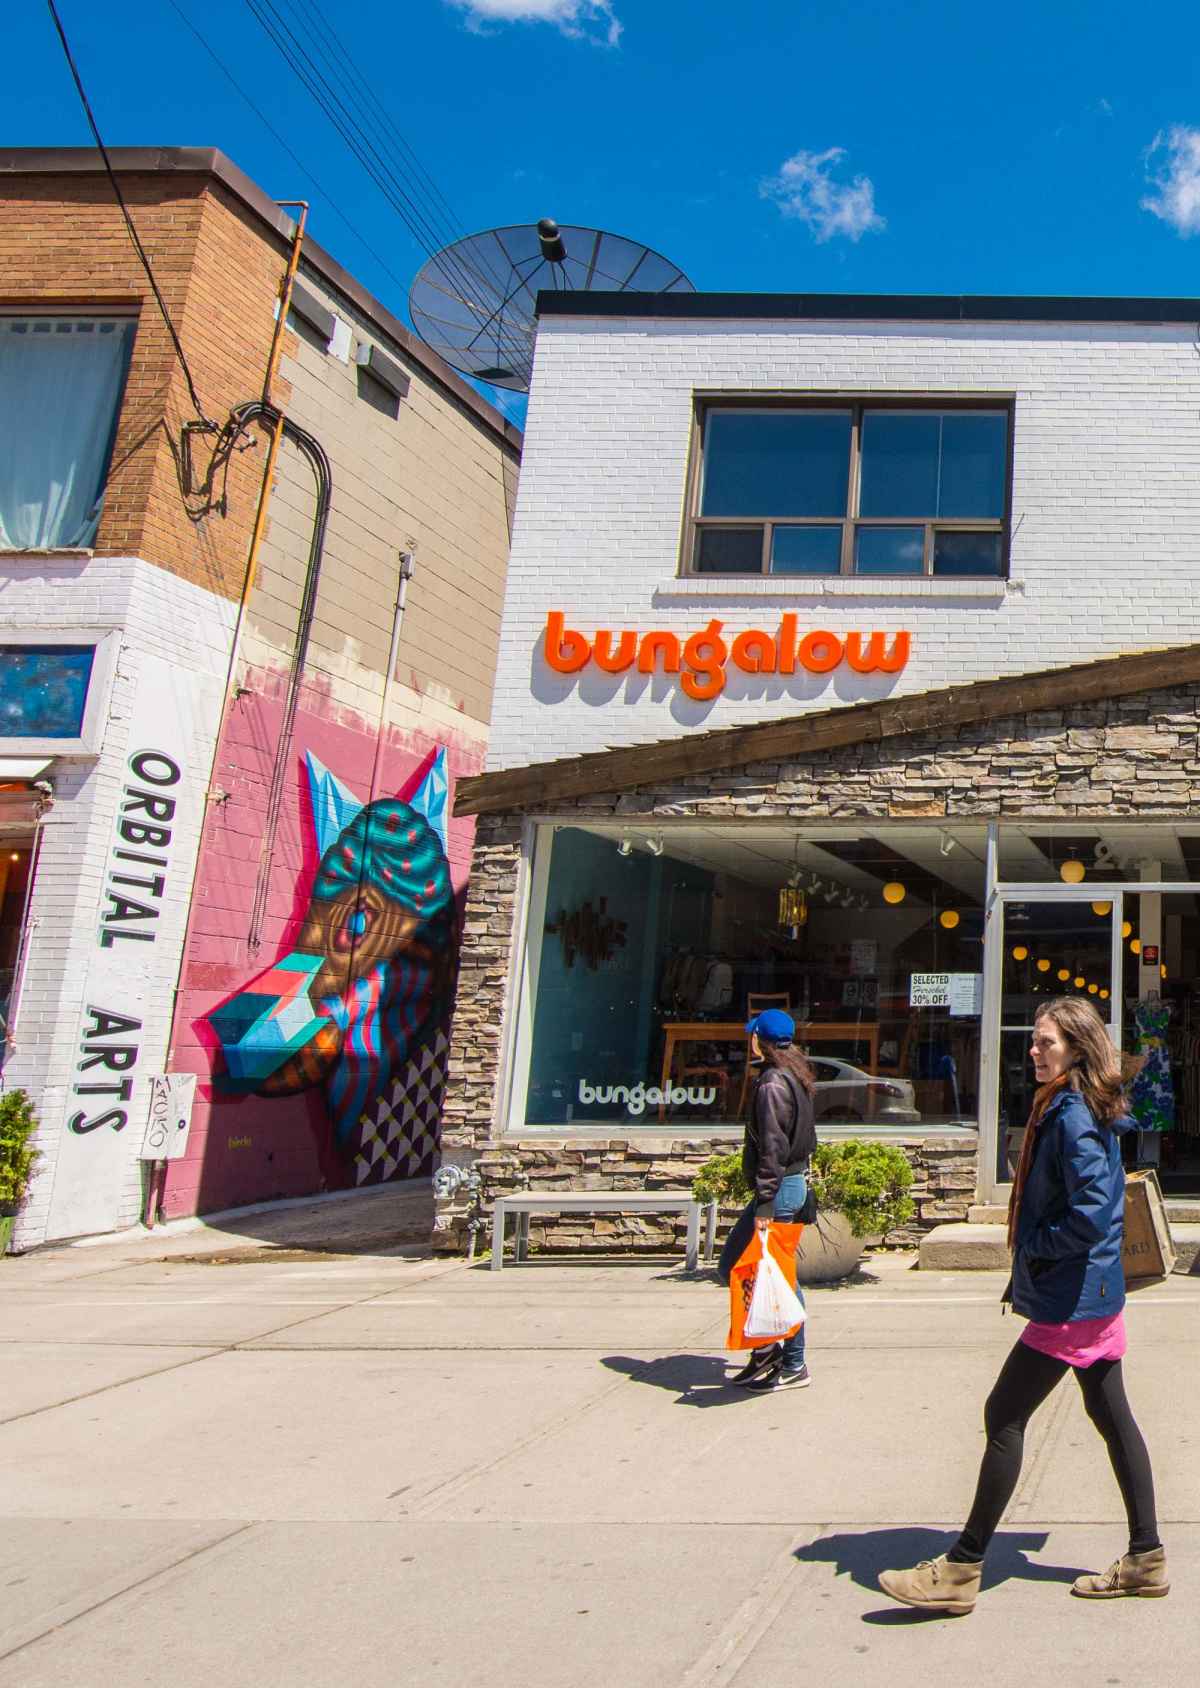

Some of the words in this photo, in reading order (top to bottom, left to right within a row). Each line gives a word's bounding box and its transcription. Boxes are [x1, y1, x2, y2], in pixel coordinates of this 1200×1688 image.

[543, 611, 911, 700] bungalow
[97, 748, 181, 948] ORBITAL
[912, 994, 930, 1005] 30%
[932, 994, 948, 1005] OFF
[913, 975, 949, 985] SELECTED
[68, 1004, 143, 1136] ARTS
[578, 1079, 717, 1116] bungalow
